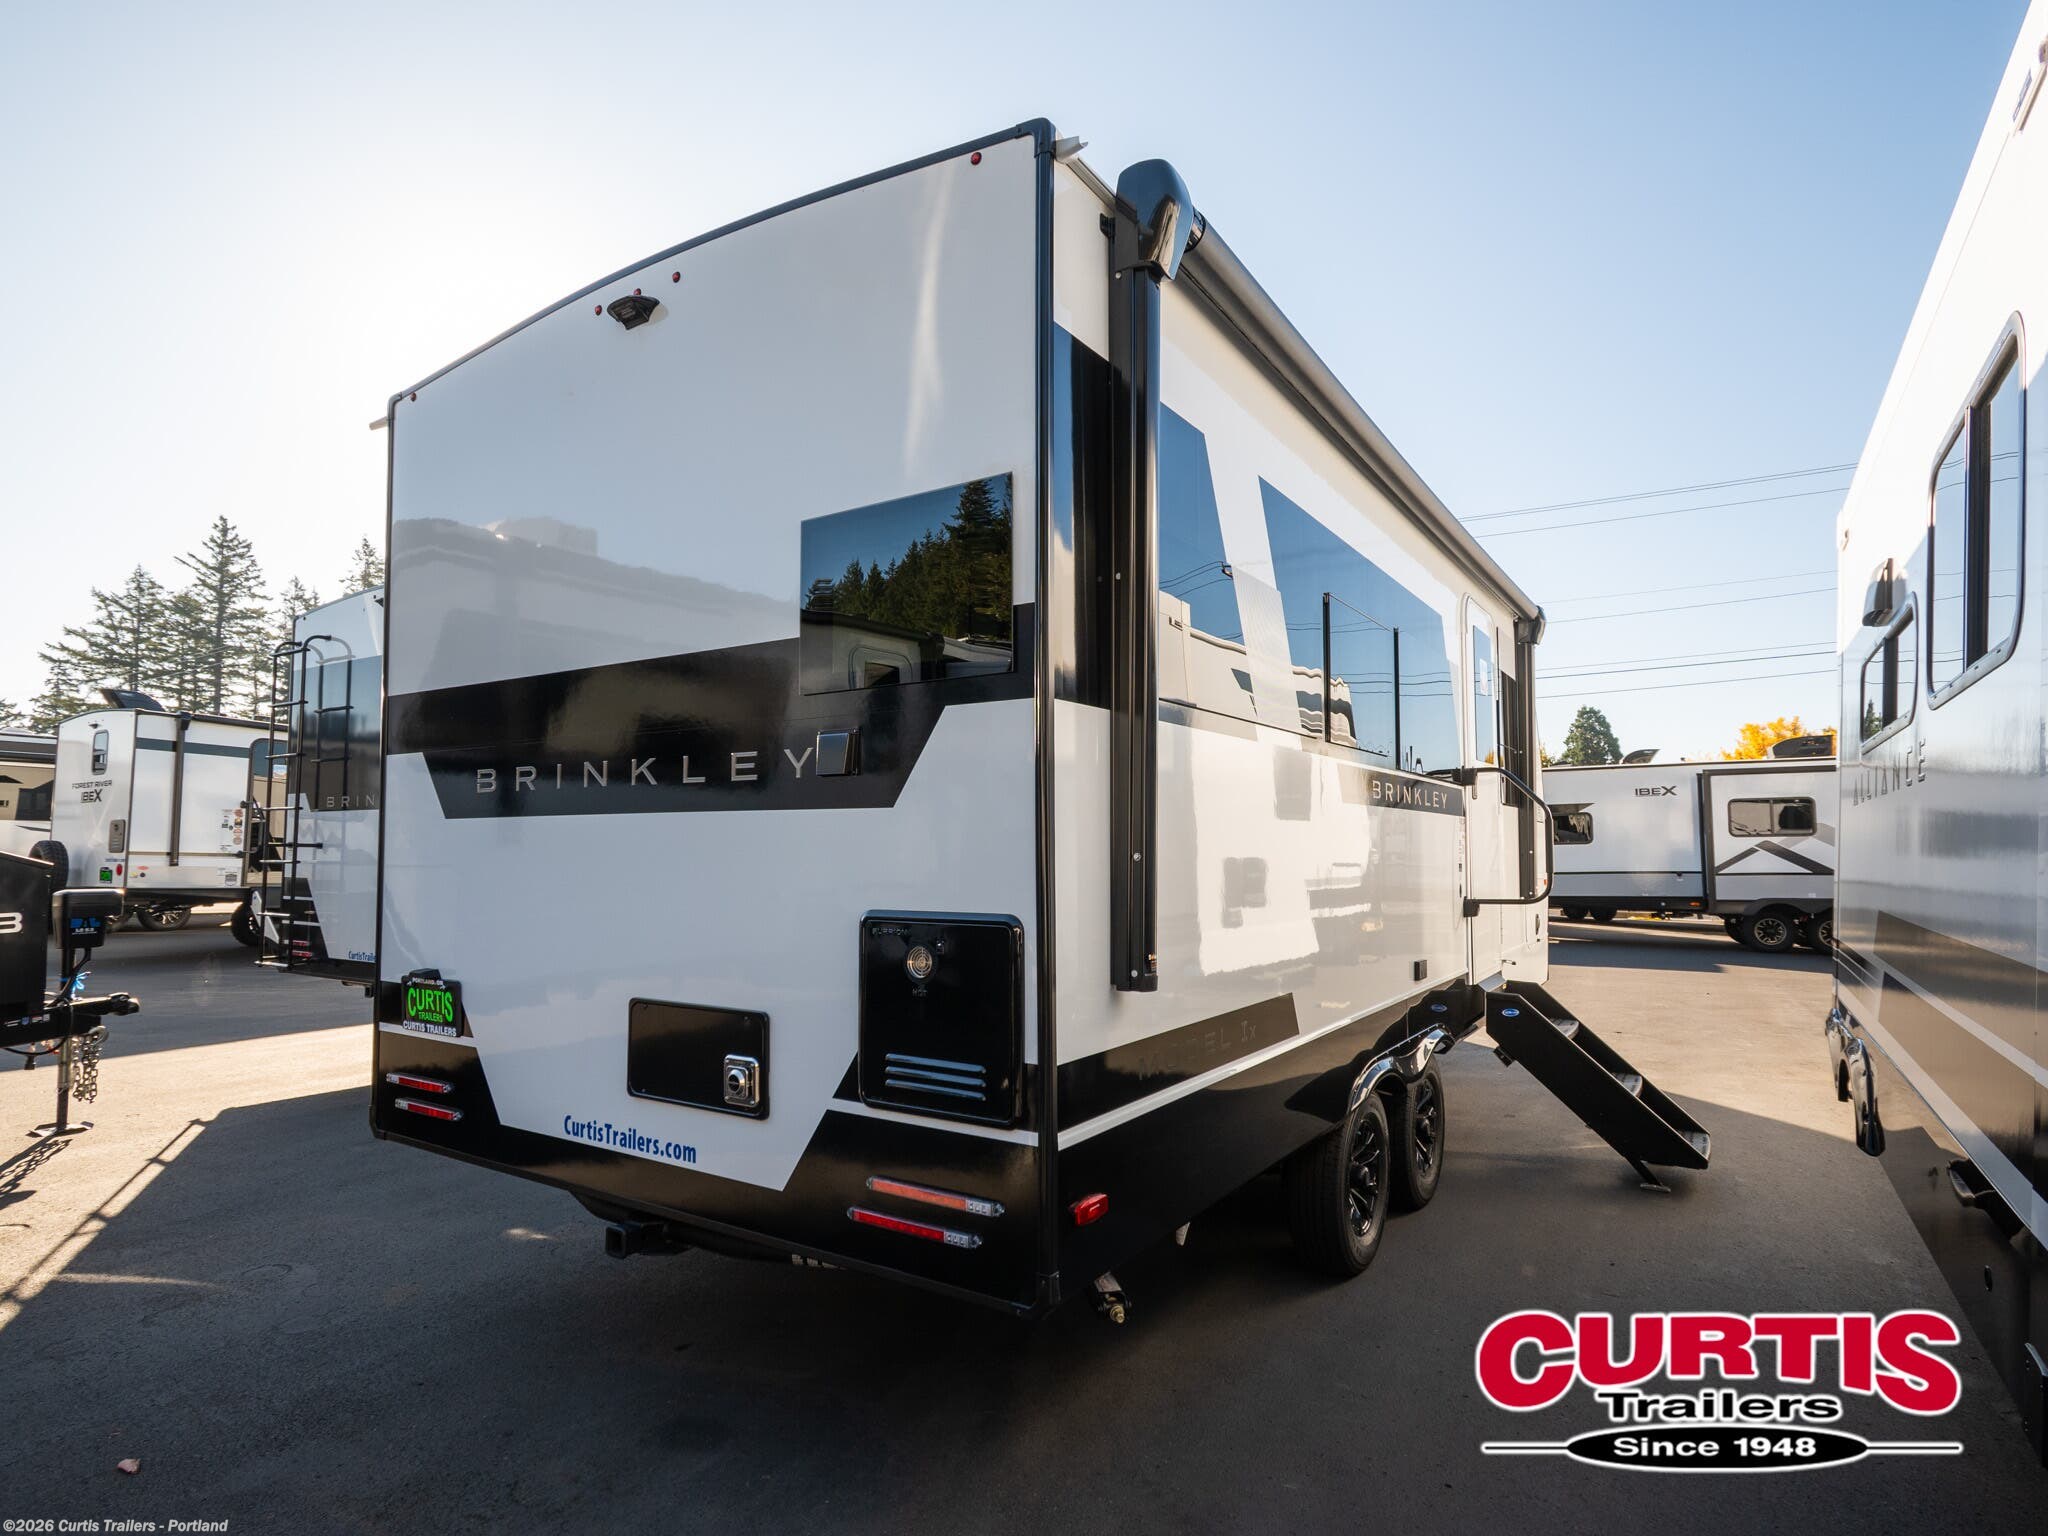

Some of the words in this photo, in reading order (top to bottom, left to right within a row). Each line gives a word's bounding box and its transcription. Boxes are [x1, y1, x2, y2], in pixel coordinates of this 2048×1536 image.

[476, 747, 813, 793] BRINKLEY
[95, 780, 112, 788] RIVER
[1635, 785, 1677, 797] IBEX
[81, 789, 102, 803] IBEX
[327, 795, 375, 808] BRIN
[1372, 780, 1448, 809] BRINKLEY
[407, 987, 454, 1022] CURTIS
[418, 1011, 443, 1023] TRAILERS
[403, 1020, 426, 1032] CURTIS
[426, 1024, 457, 1037] TRAILERS
[564, 1115, 697, 1164] CurtisTrailers.com
